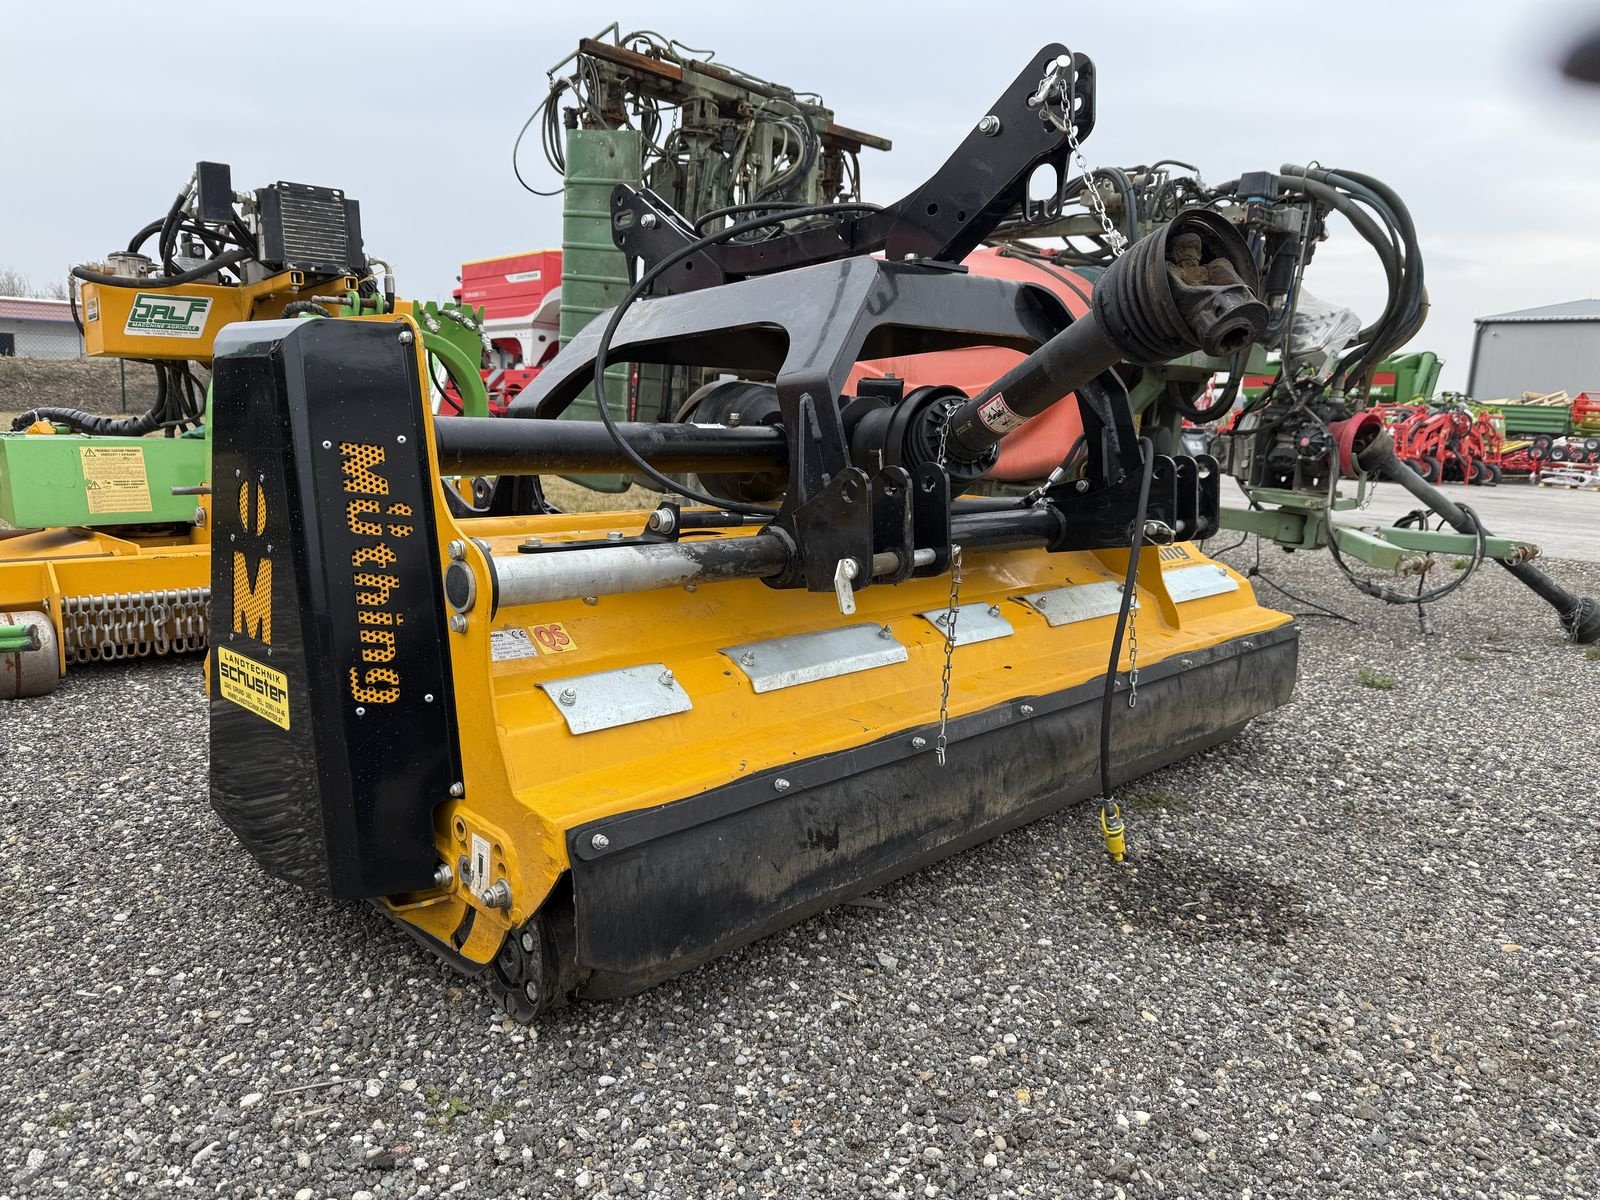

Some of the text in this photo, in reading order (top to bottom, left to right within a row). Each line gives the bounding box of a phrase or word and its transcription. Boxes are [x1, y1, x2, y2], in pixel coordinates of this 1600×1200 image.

[339, 441, 414, 704] Müthing
[534, 624, 570, 652] QS
[224, 652, 281, 685] LANDTECHNIK
